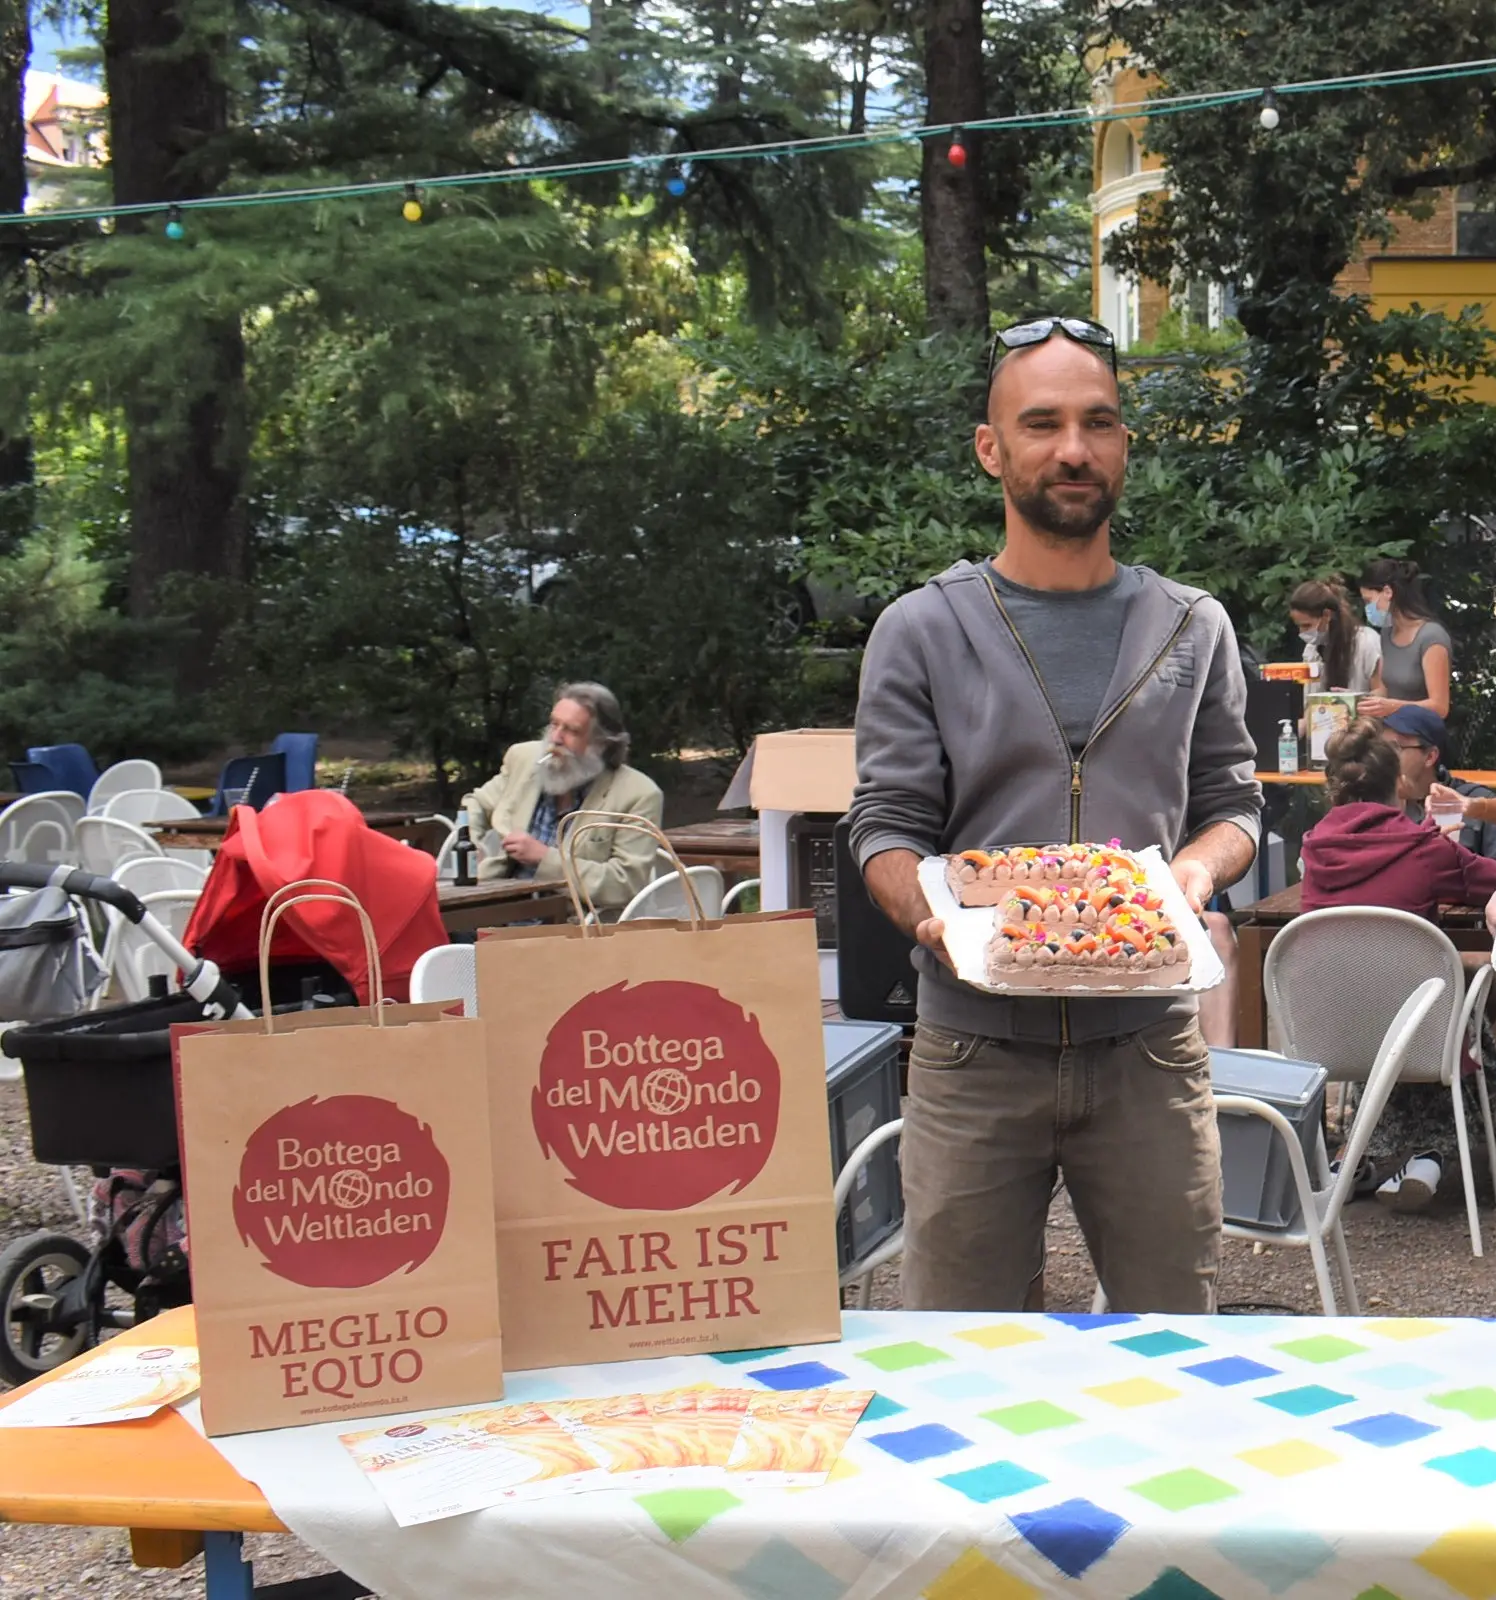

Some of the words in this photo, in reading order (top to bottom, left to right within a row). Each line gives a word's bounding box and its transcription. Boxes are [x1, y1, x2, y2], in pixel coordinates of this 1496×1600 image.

[581, 1029, 725, 1072] Bottega
[546, 1078, 592, 1108] del
[276, 1138, 401, 1172] Bottega
[567, 1115, 761, 1159] Weltladen
[246, 1179, 286, 1203] del
[263, 1208, 433, 1246] Weltladen
[541, 1230, 678, 1282] FAIR
[695, 1220, 788, 1268] IST
[585, 1276, 761, 1330] MEHR
[248, 1305, 448, 1359] MEGLIO
[280, 1348, 424, 1399] EQUO
